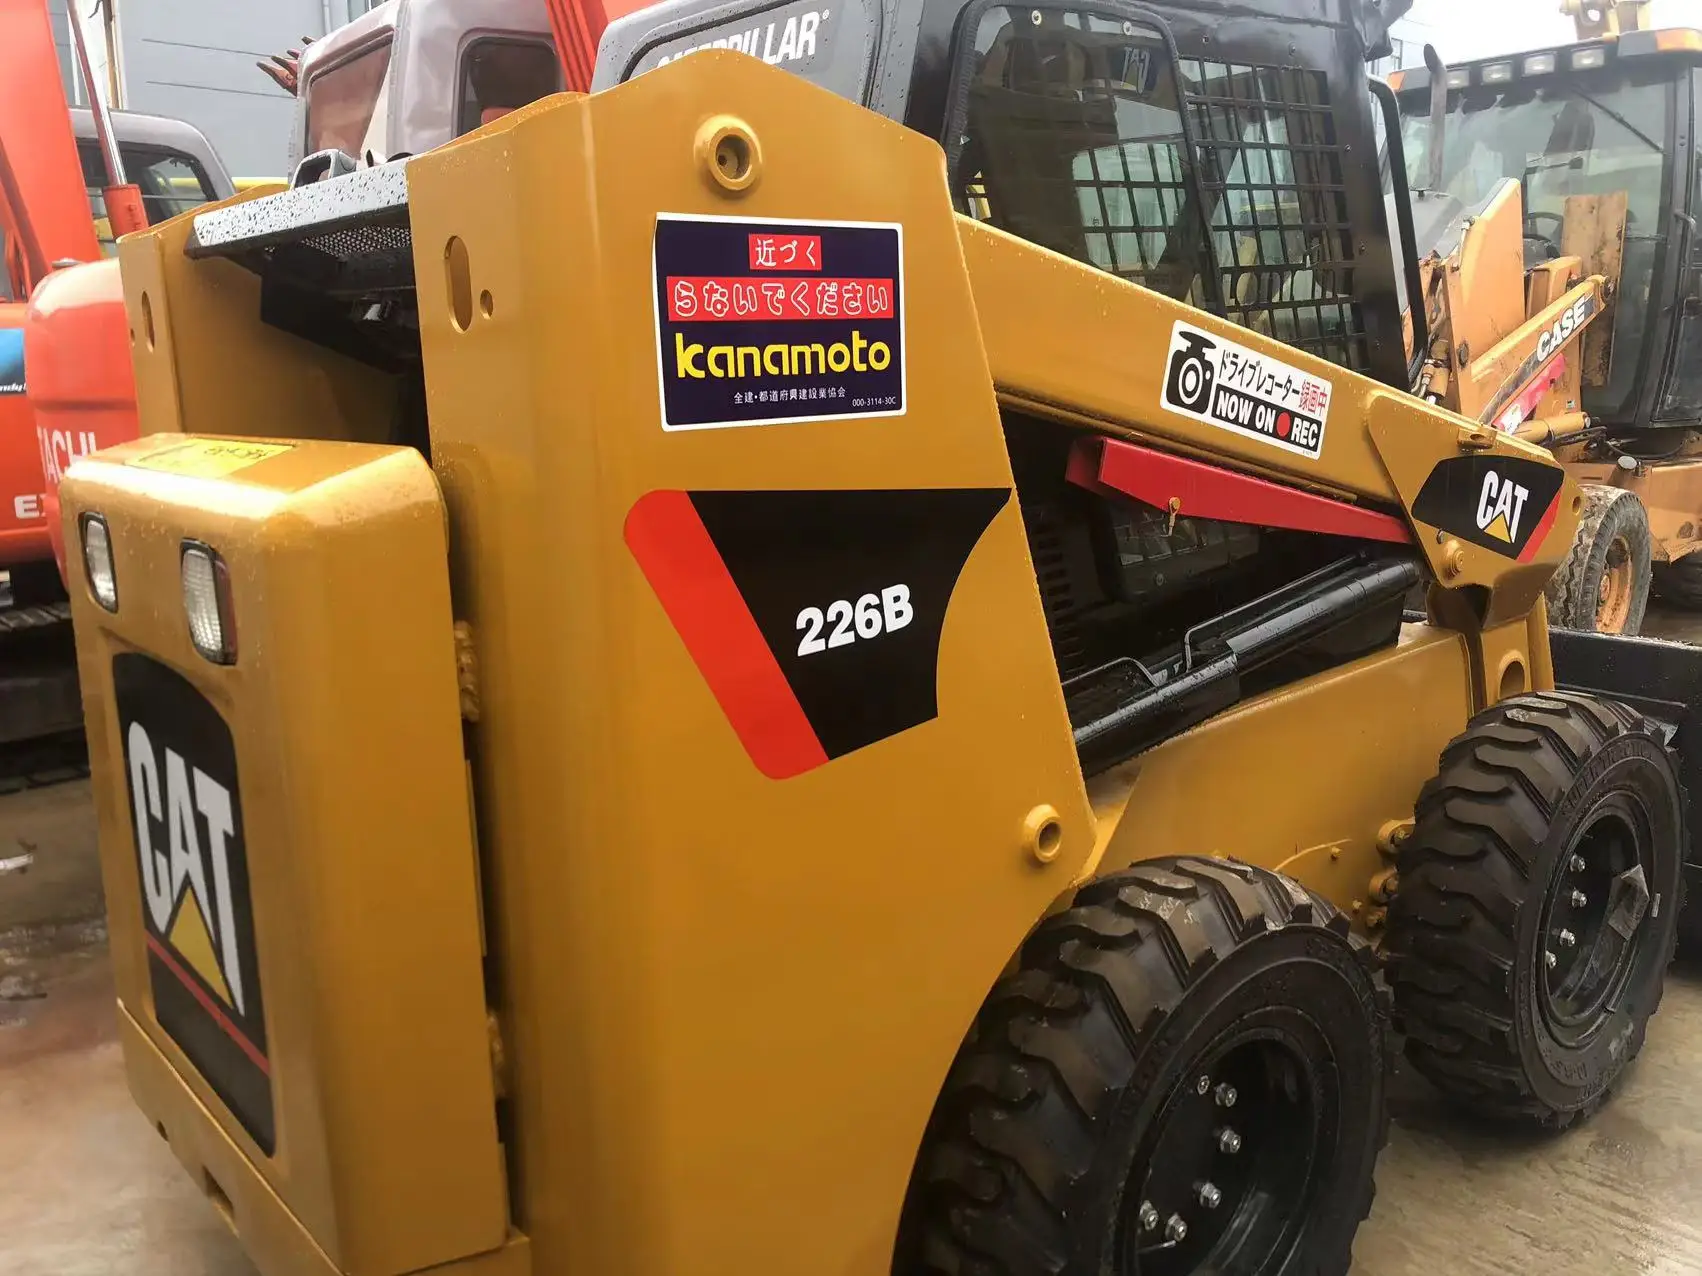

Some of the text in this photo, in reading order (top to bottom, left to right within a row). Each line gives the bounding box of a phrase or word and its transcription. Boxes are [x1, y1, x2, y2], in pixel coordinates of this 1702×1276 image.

[755, 239, 817, 267] 近づく
[674, 281, 888, 317] らないでください
[675, 330, 891, 378] kanamoto
[1537, 296, 1586, 362] CASE
[852, 396, 897, 407] 000-3114-30C
[1216, 390, 1318, 447] NOW ON REC
[1476, 470, 1529, 543] CAT
[796, 584, 914, 657] 226B
[128, 721, 245, 1018] CAT
